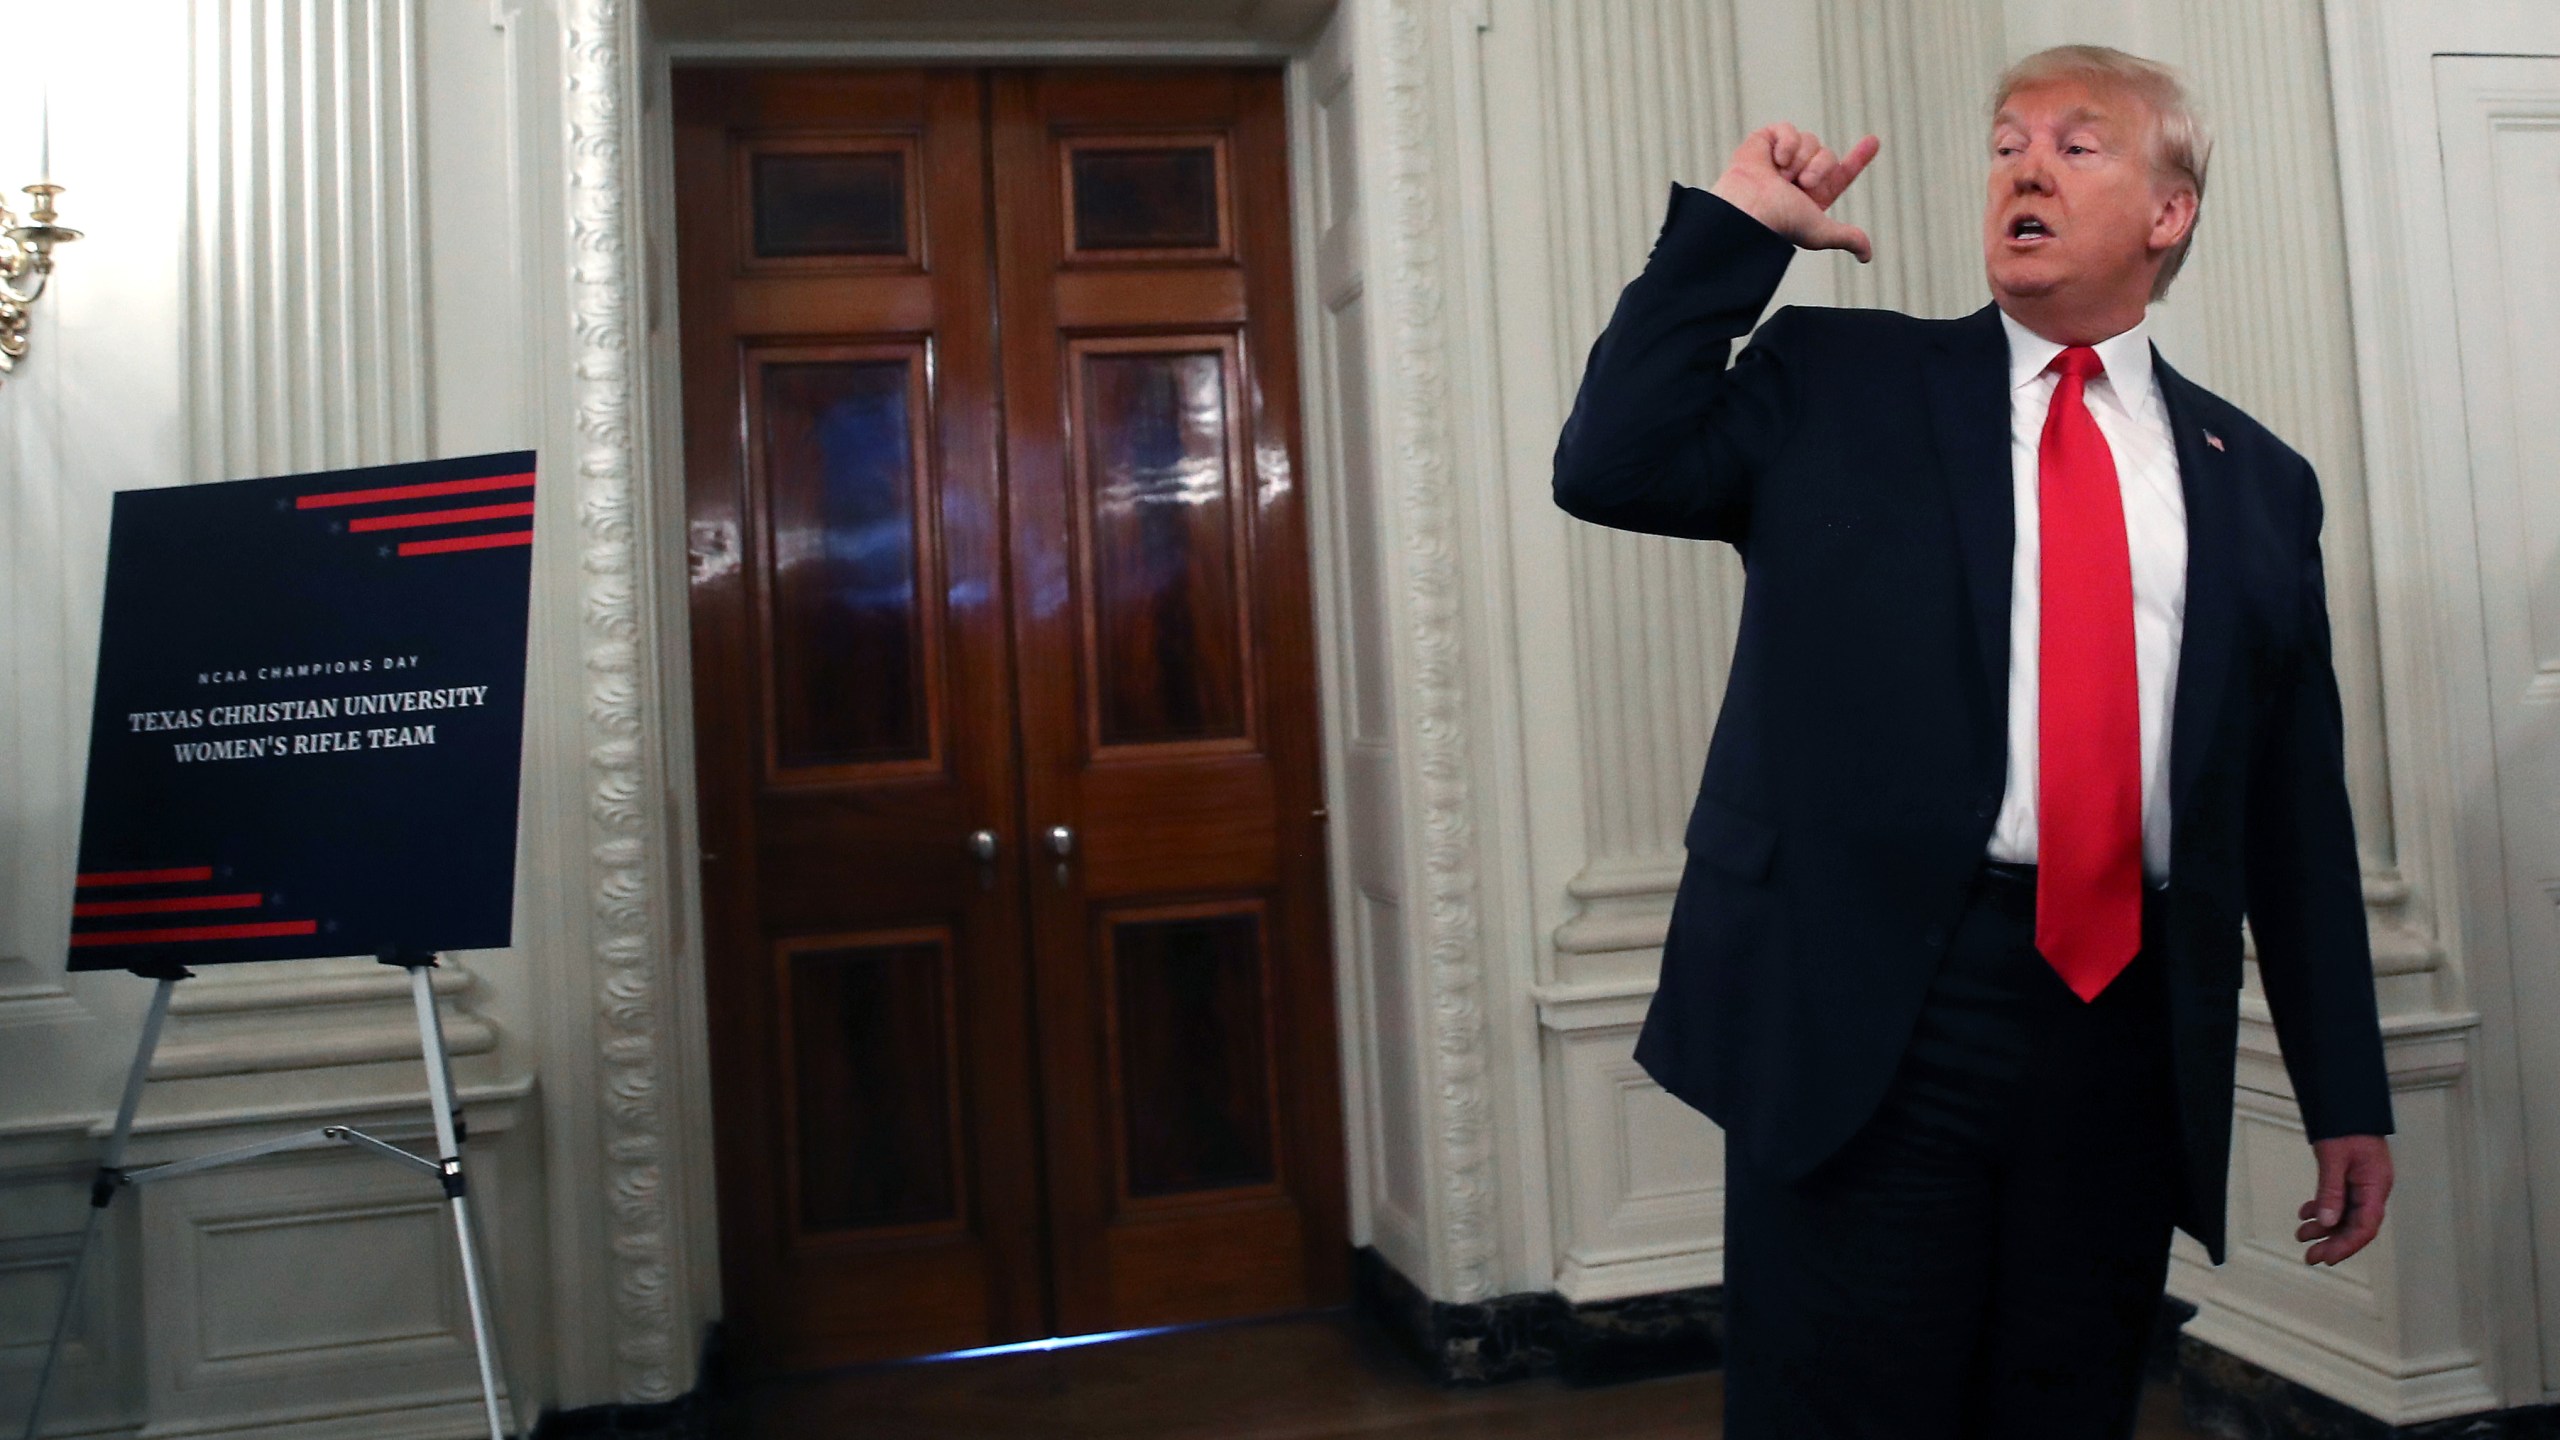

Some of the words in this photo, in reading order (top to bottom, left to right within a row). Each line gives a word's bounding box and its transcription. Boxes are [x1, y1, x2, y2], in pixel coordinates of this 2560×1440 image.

[199, 669, 248, 684] NCAA
[258, 660, 374, 681] CHAMPIONS
[383, 655, 420, 670] DAY
[129, 707, 204, 732] TEXAS
[208, 697, 340, 727] CHRISTIAN
[343, 685, 489, 717] UNIVERSITY
[173, 735, 289, 763] WOMEN'S
[293, 730, 363, 755] RIFLE
[367, 724, 437, 750] TEAM
